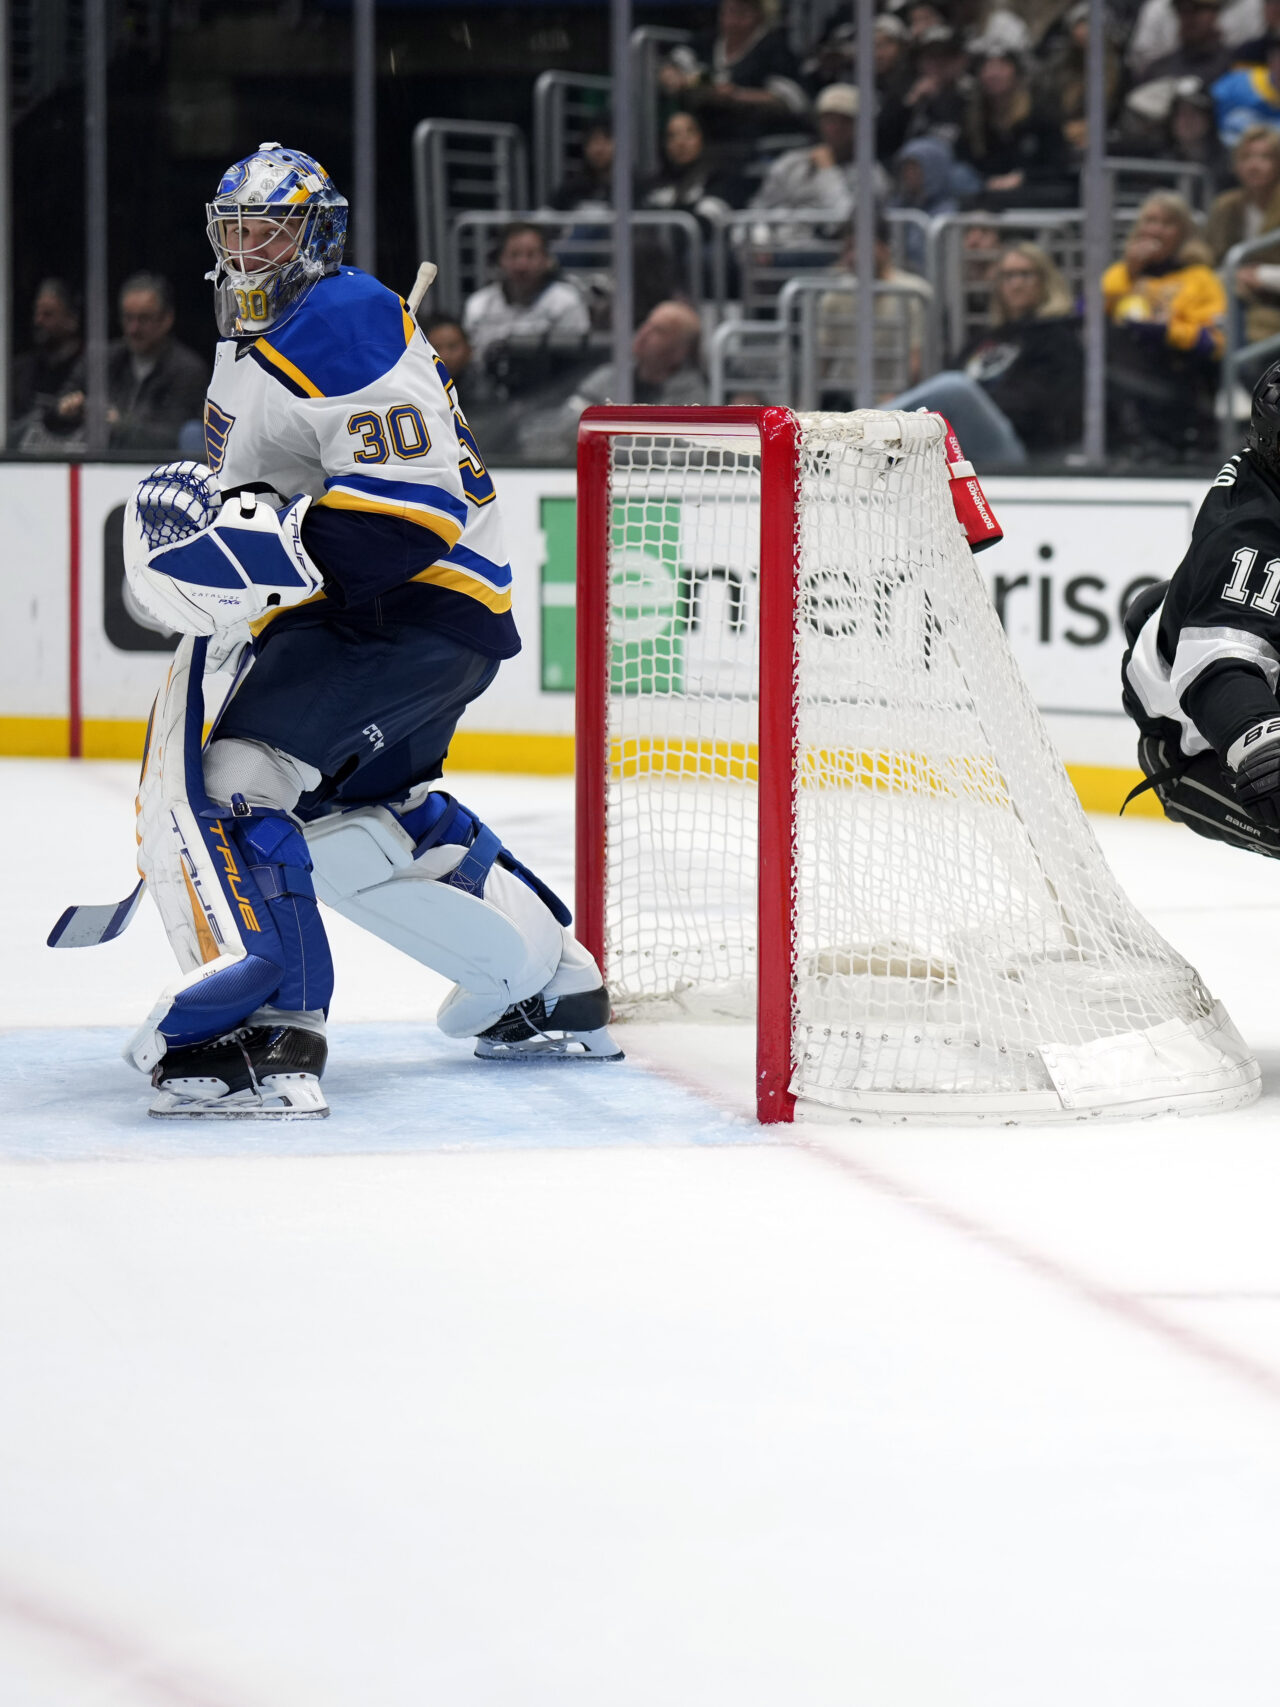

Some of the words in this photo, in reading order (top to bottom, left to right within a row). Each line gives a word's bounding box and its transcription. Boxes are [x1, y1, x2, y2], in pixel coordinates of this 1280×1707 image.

[234, 289, 268, 320] 30
[347, 404, 432, 464] 30
[966, 480, 995, 531] BODYARMOR
[170, 808, 225, 945] TRUE
[209, 819, 262, 933] TRUE
